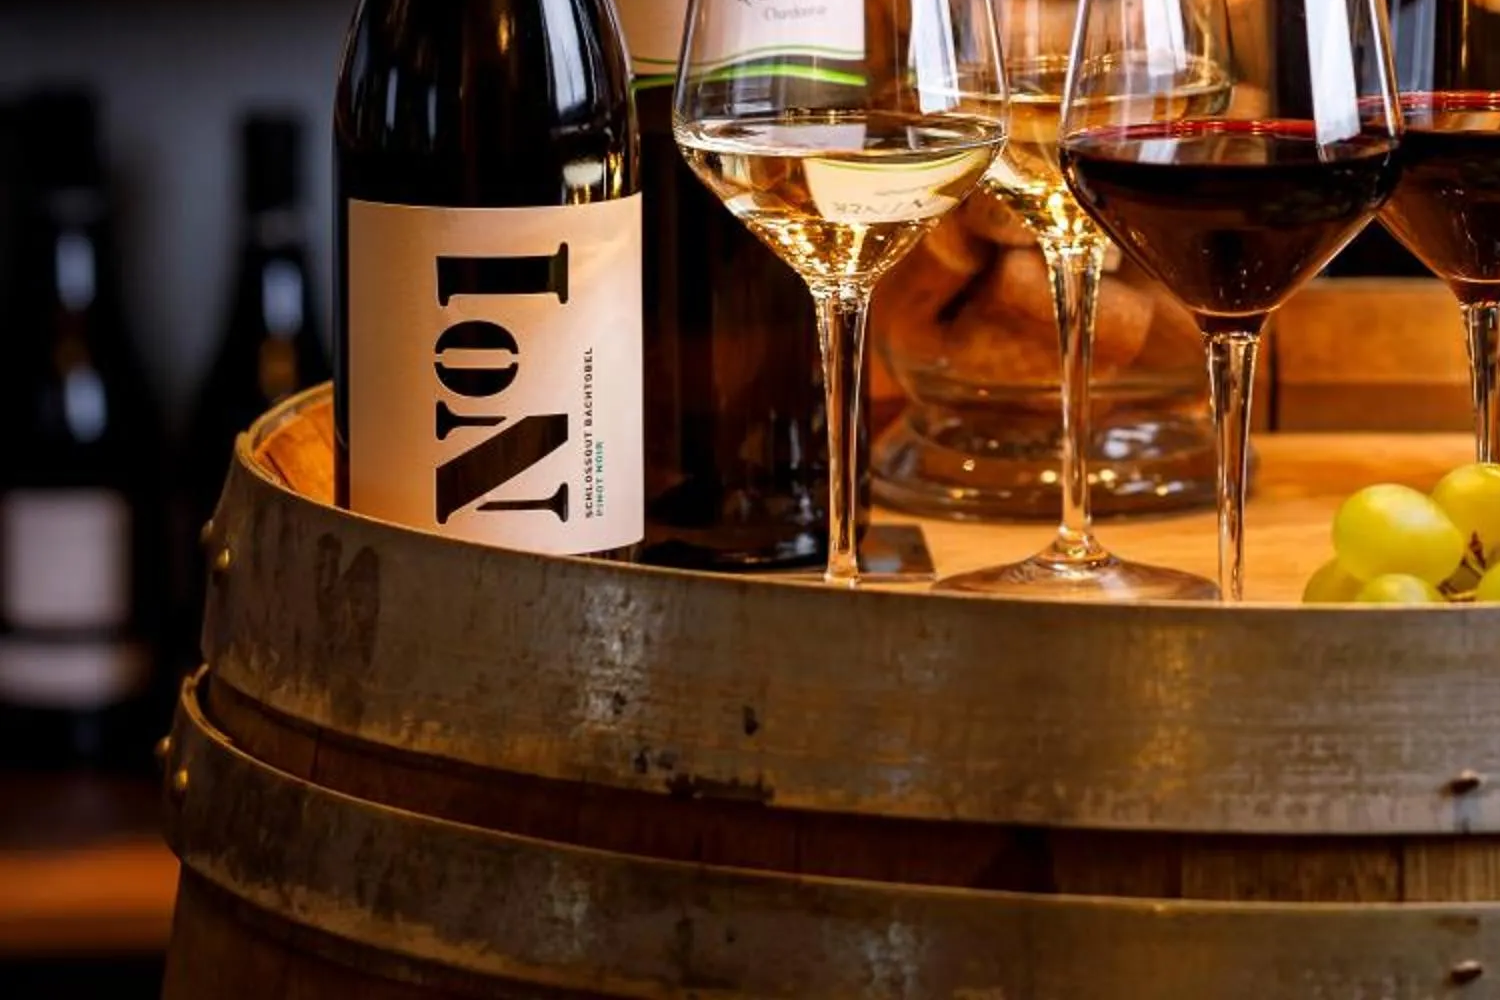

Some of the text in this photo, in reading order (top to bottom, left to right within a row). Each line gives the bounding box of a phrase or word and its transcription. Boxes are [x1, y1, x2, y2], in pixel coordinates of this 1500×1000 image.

[583, 347, 593, 518] SCHLOSSGUT BACHTOBEL
[595, 441, 604, 517] PINOT NOIR
